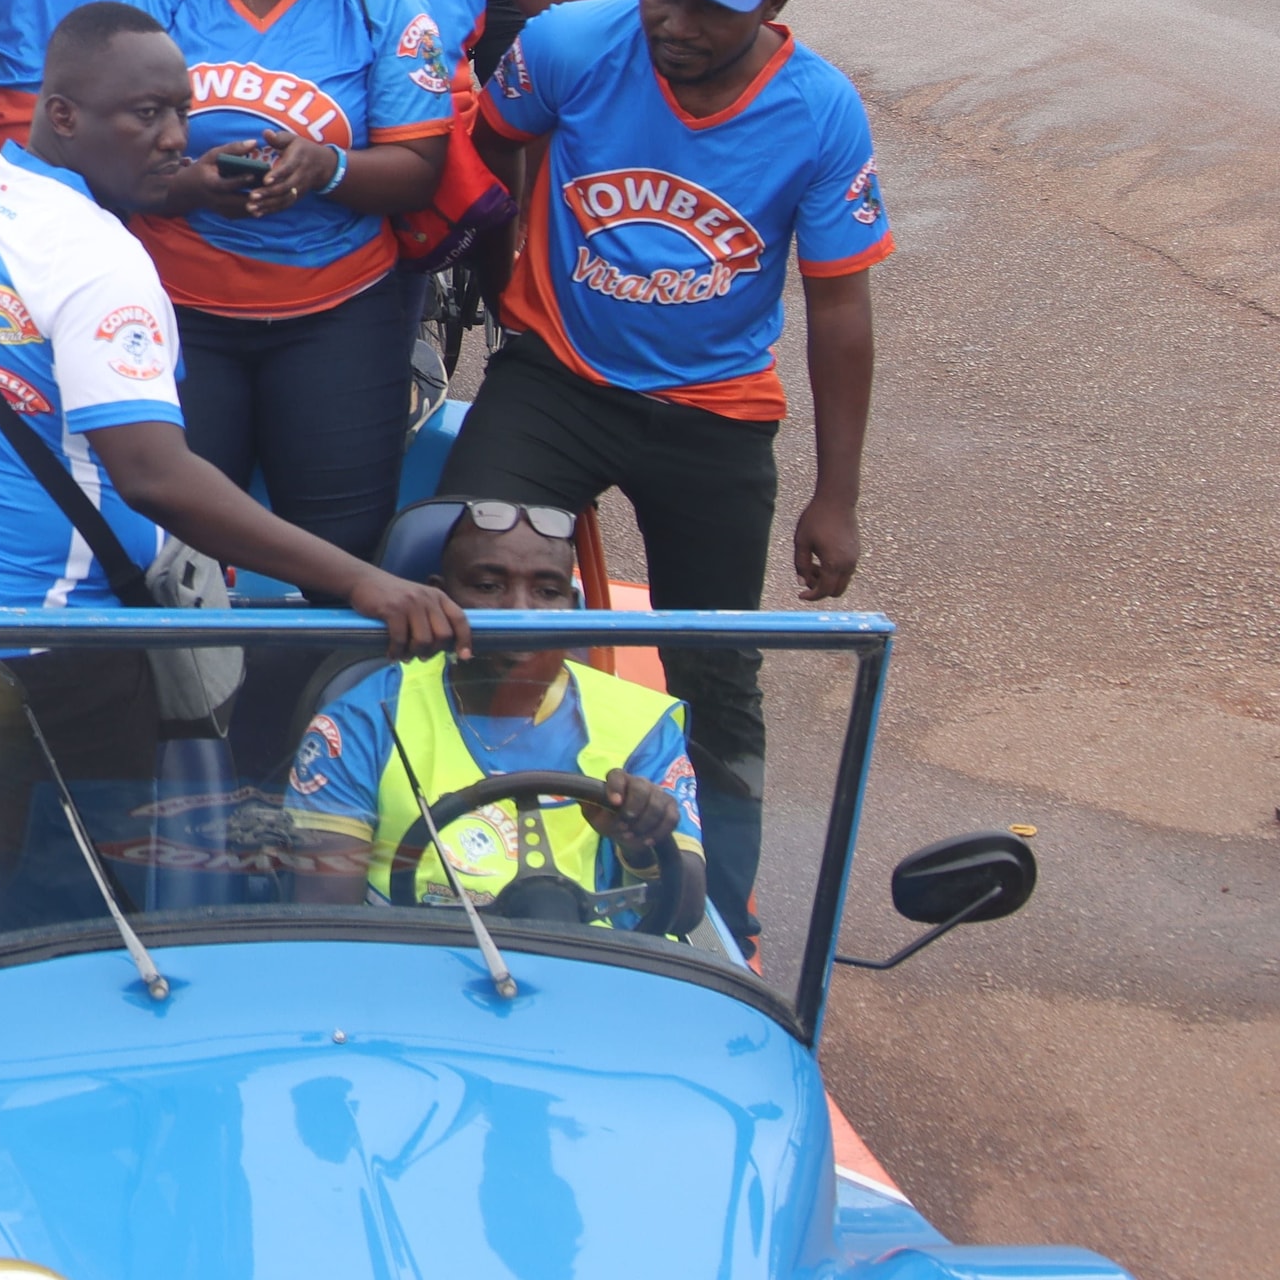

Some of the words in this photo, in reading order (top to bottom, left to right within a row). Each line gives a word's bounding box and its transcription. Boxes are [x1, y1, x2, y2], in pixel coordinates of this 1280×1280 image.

[193, 68, 337, 143] WBELL
[572, 246, 734, 305] VitaRich
[101, 308, 160, 334] COWBELL
